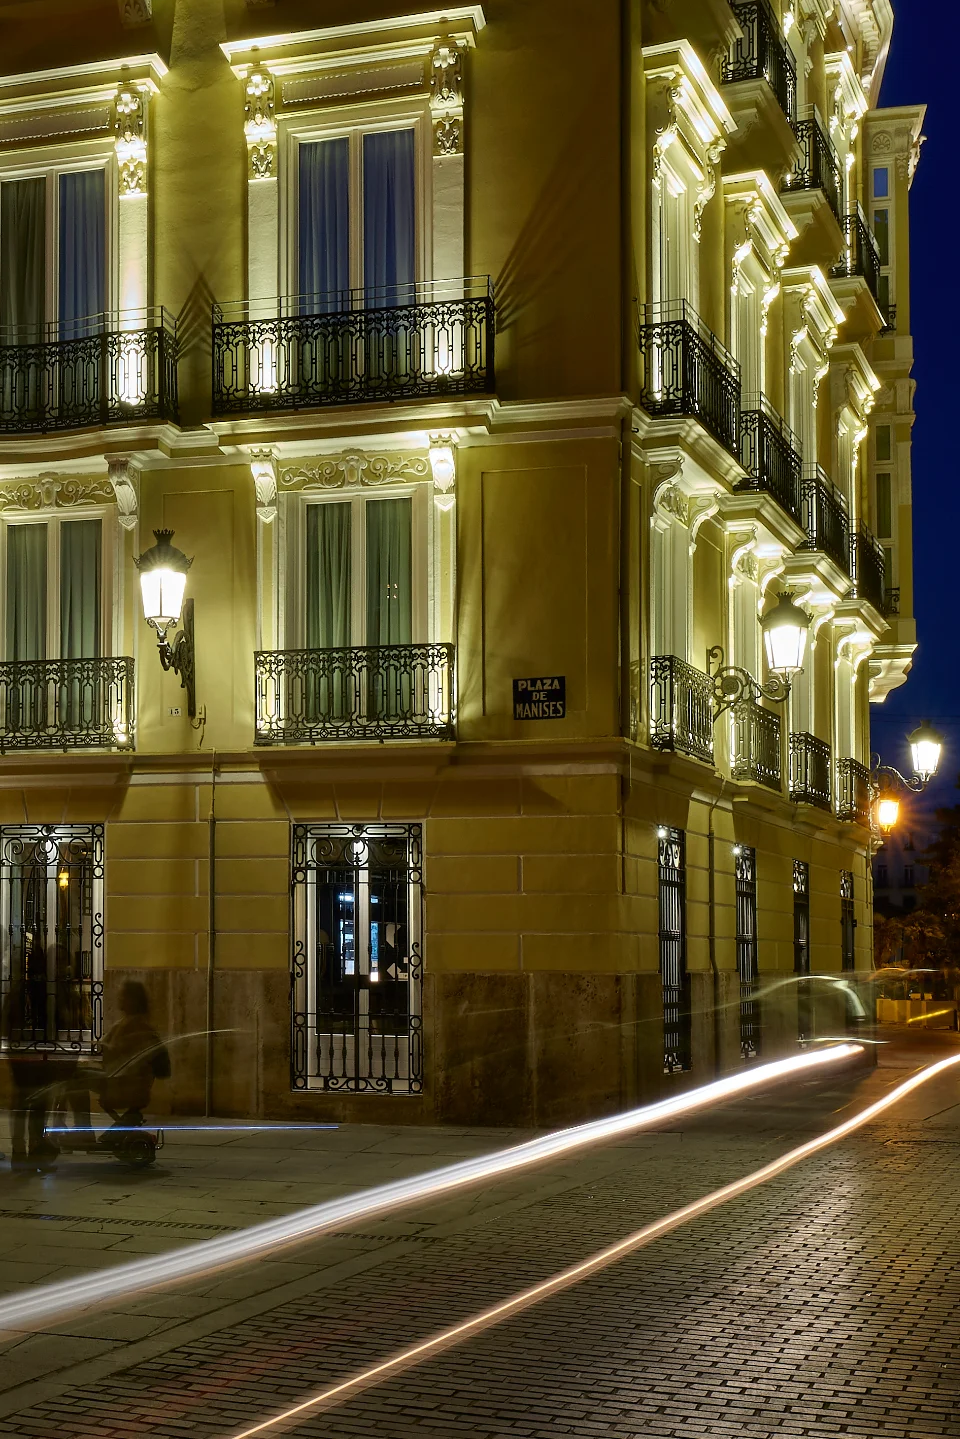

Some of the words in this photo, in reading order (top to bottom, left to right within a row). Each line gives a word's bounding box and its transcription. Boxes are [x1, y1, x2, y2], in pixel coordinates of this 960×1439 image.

[518, 678, 560, 691] PLAZA
[532, 691, 548, 701] DE
[515, 701, 564, 718] MANISES
